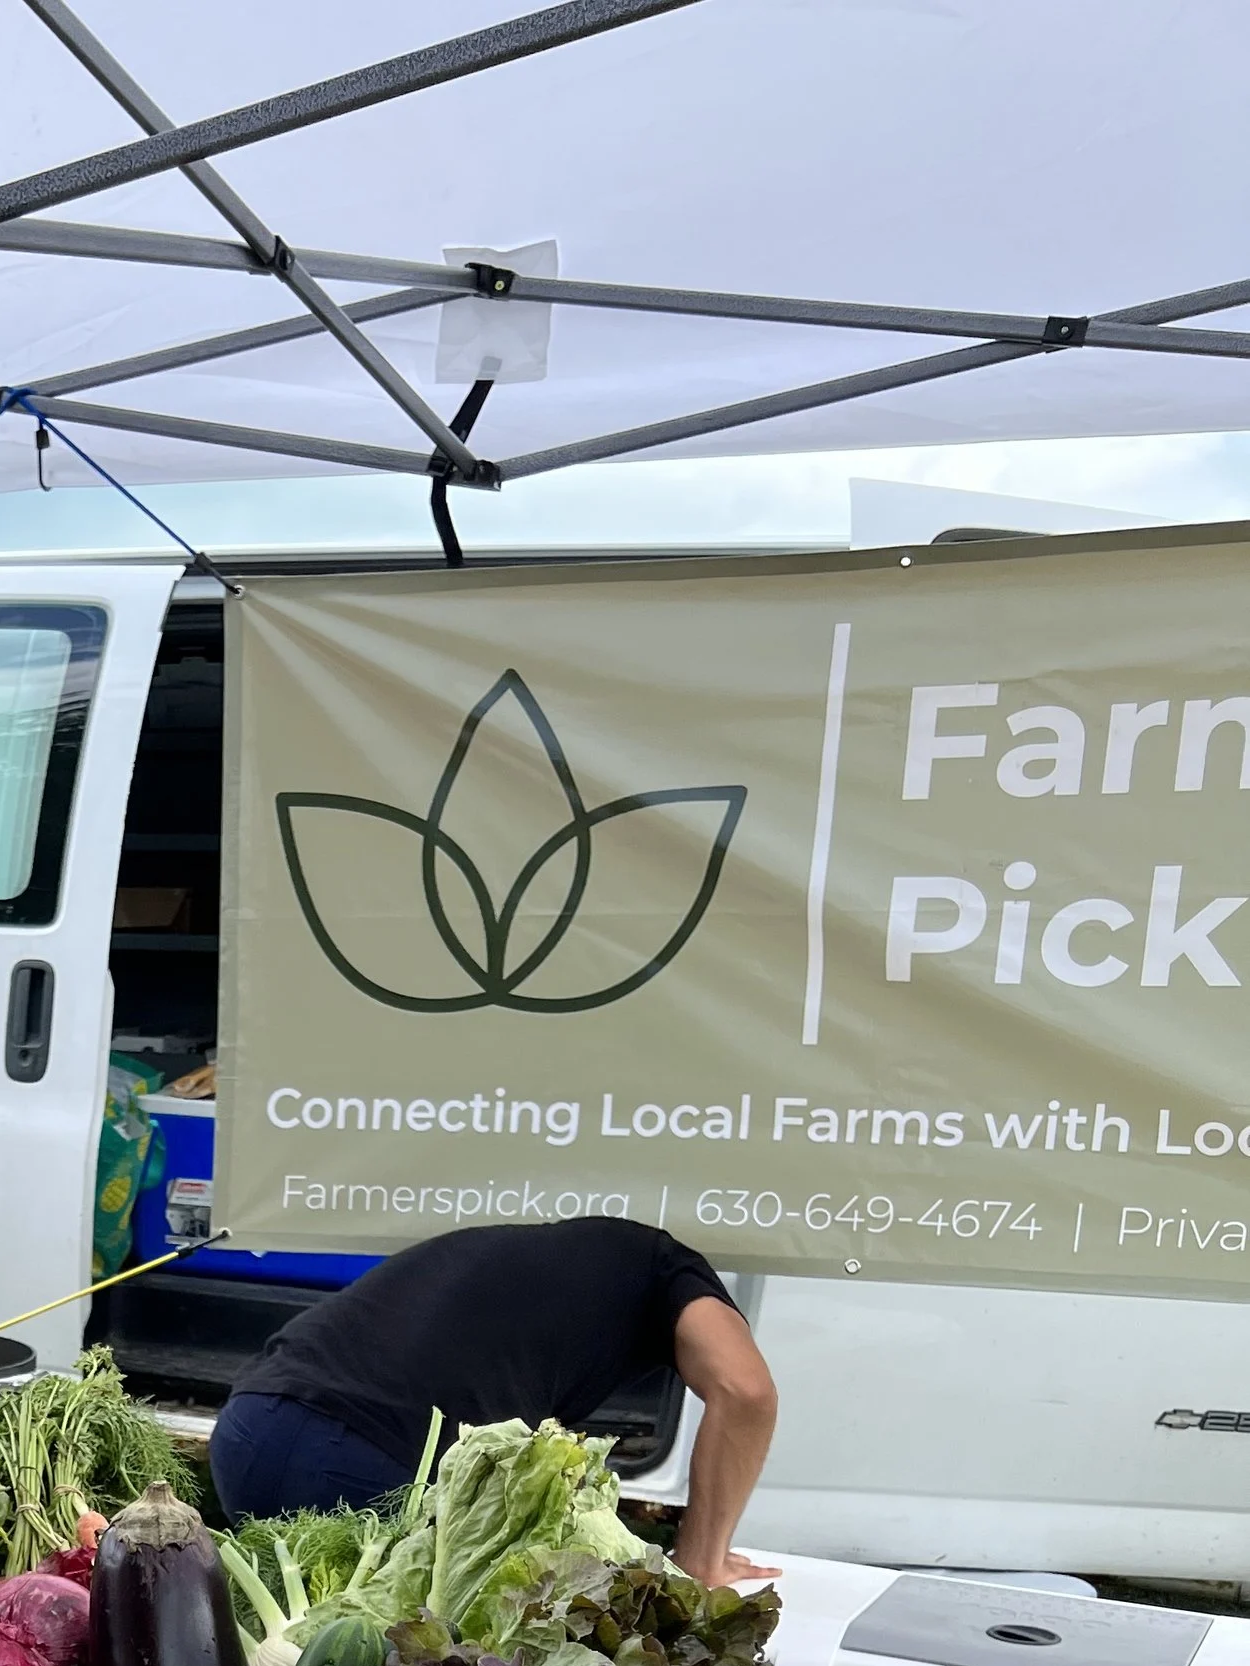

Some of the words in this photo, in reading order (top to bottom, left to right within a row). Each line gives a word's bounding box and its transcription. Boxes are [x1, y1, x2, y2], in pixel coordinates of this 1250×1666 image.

[885, 861, 1249, 987] Pick
[267, 1087, 580, 1146] Connecting
[600, 1093, 751, 1140] Local
[772, 1097, 965, 1147] Farms
[984, 1100, 1131, 1154] with
[695, 1189, 1043, 1241] 630-649-4674
